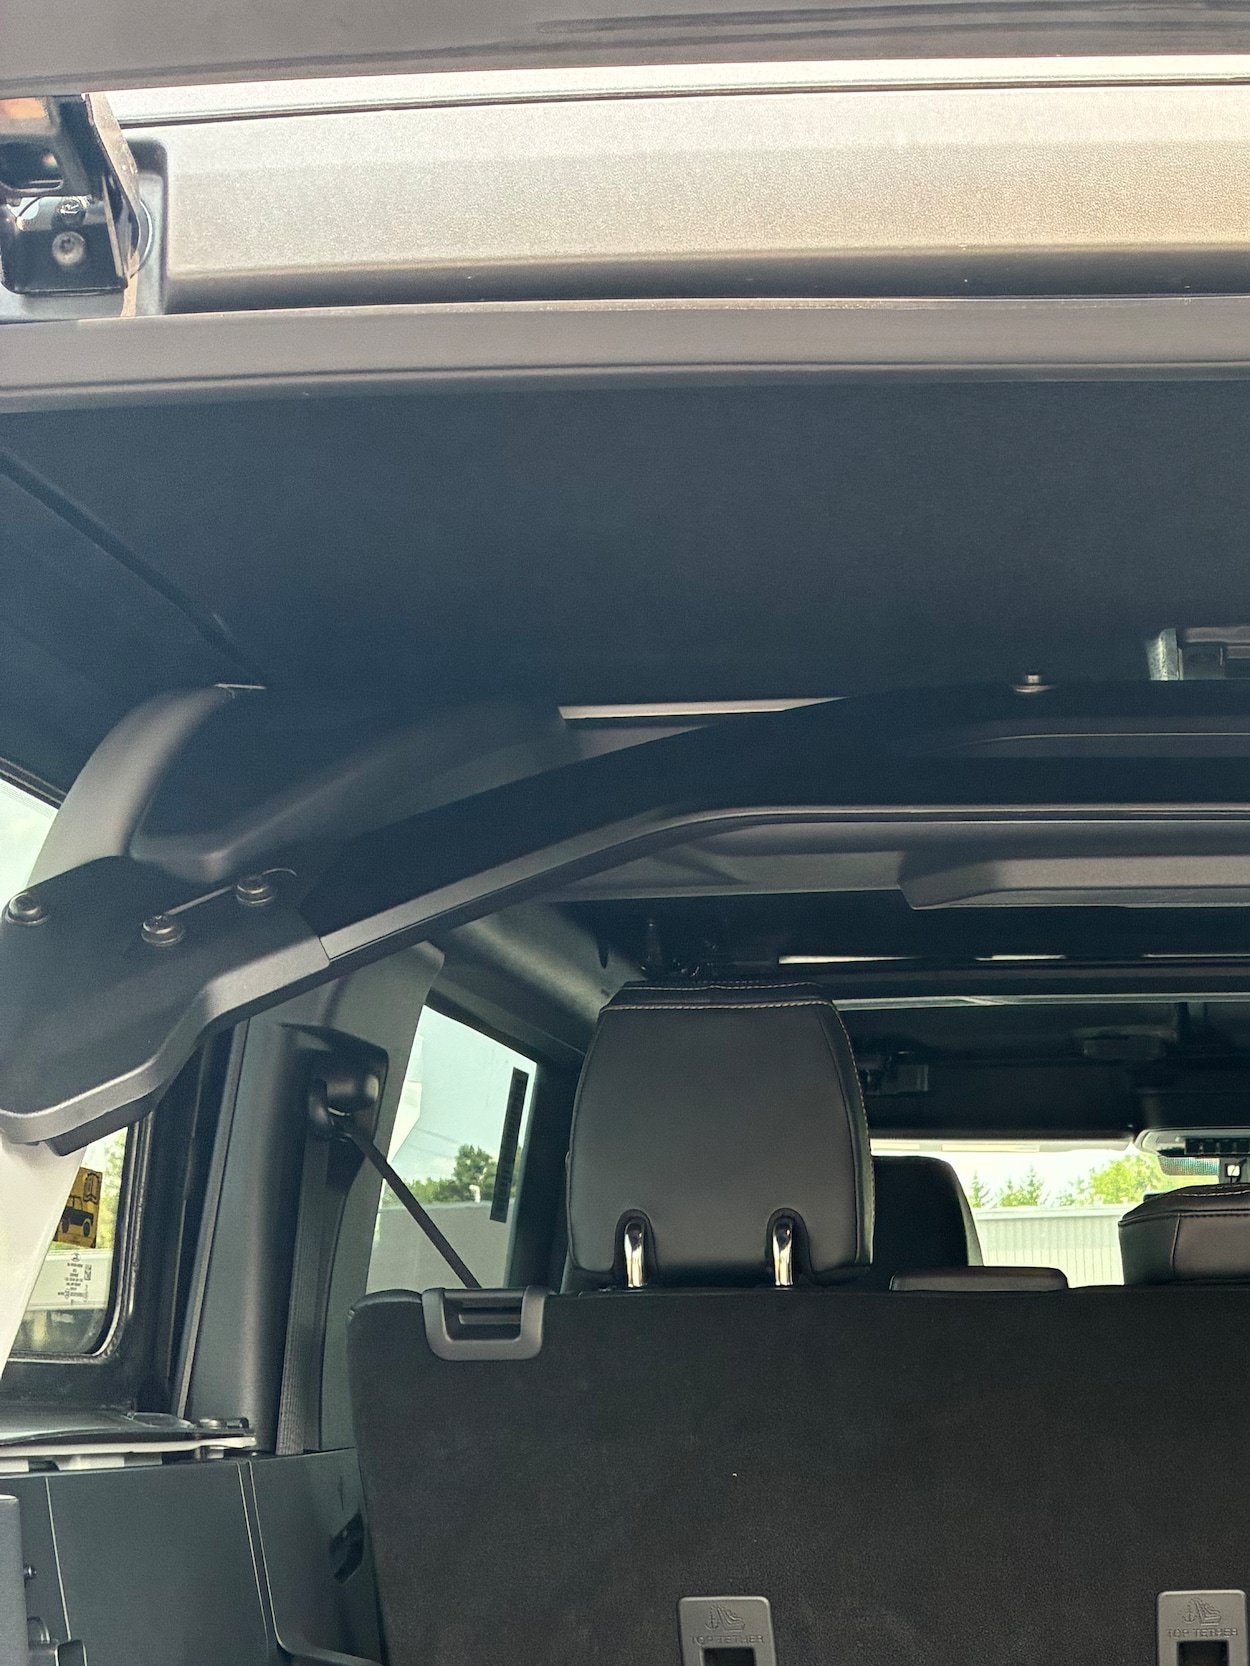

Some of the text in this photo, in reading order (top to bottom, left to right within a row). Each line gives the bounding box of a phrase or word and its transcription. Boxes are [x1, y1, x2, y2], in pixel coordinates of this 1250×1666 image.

[1167, 1628, 1238, 1638] TOP TETHER
[689, 1634, 764, 1644] TOP TETHER
